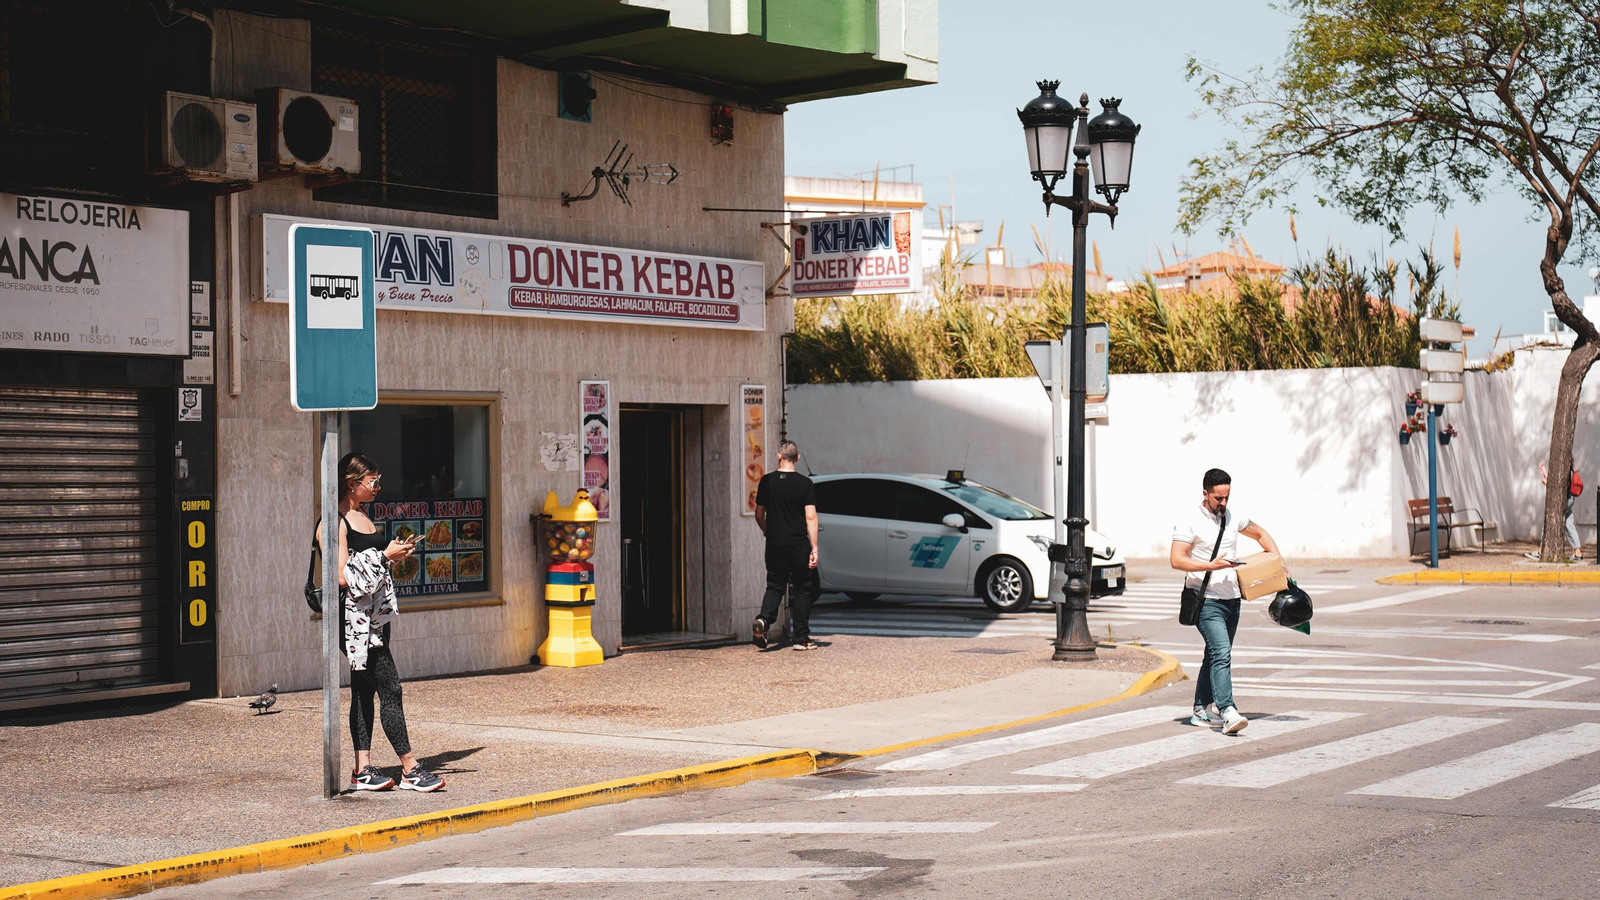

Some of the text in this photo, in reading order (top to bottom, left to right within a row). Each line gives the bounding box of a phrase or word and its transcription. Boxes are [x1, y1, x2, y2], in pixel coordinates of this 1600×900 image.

[17, 198, 141, 230] RELOJERIA
[812, 217, 891, 253] KHAN
[373, 231, 454, 286] AN
[794, 255, 908, 281] DONER KEBAB
[507, 243, 735, 300] DONER KEBAB
[55, 285, 79, 295] DESDE
[82, 287, 100, 296] 1950
[378, 286, 454, 304] y Buen Precio
[514, 290, 544, 306] KEBAB,
[544, 293, 610, 310] HAMBURGUESAS,
[611, 297, 654, 313] LAHMACUM,
[655, 301, 688, 316] FALAFEL,
[33, 331, 70, 343] RADO
[79, 333, 117, 346] TISSOT
[181, 500, 210, 511] COMPRO
[374, 502, 430, 520] DONER
[434, 500, 483, 518] KEBAB
[188, 520, 207, 627] ORO
[394, 584, 459, 596] PARA LLEVAR
